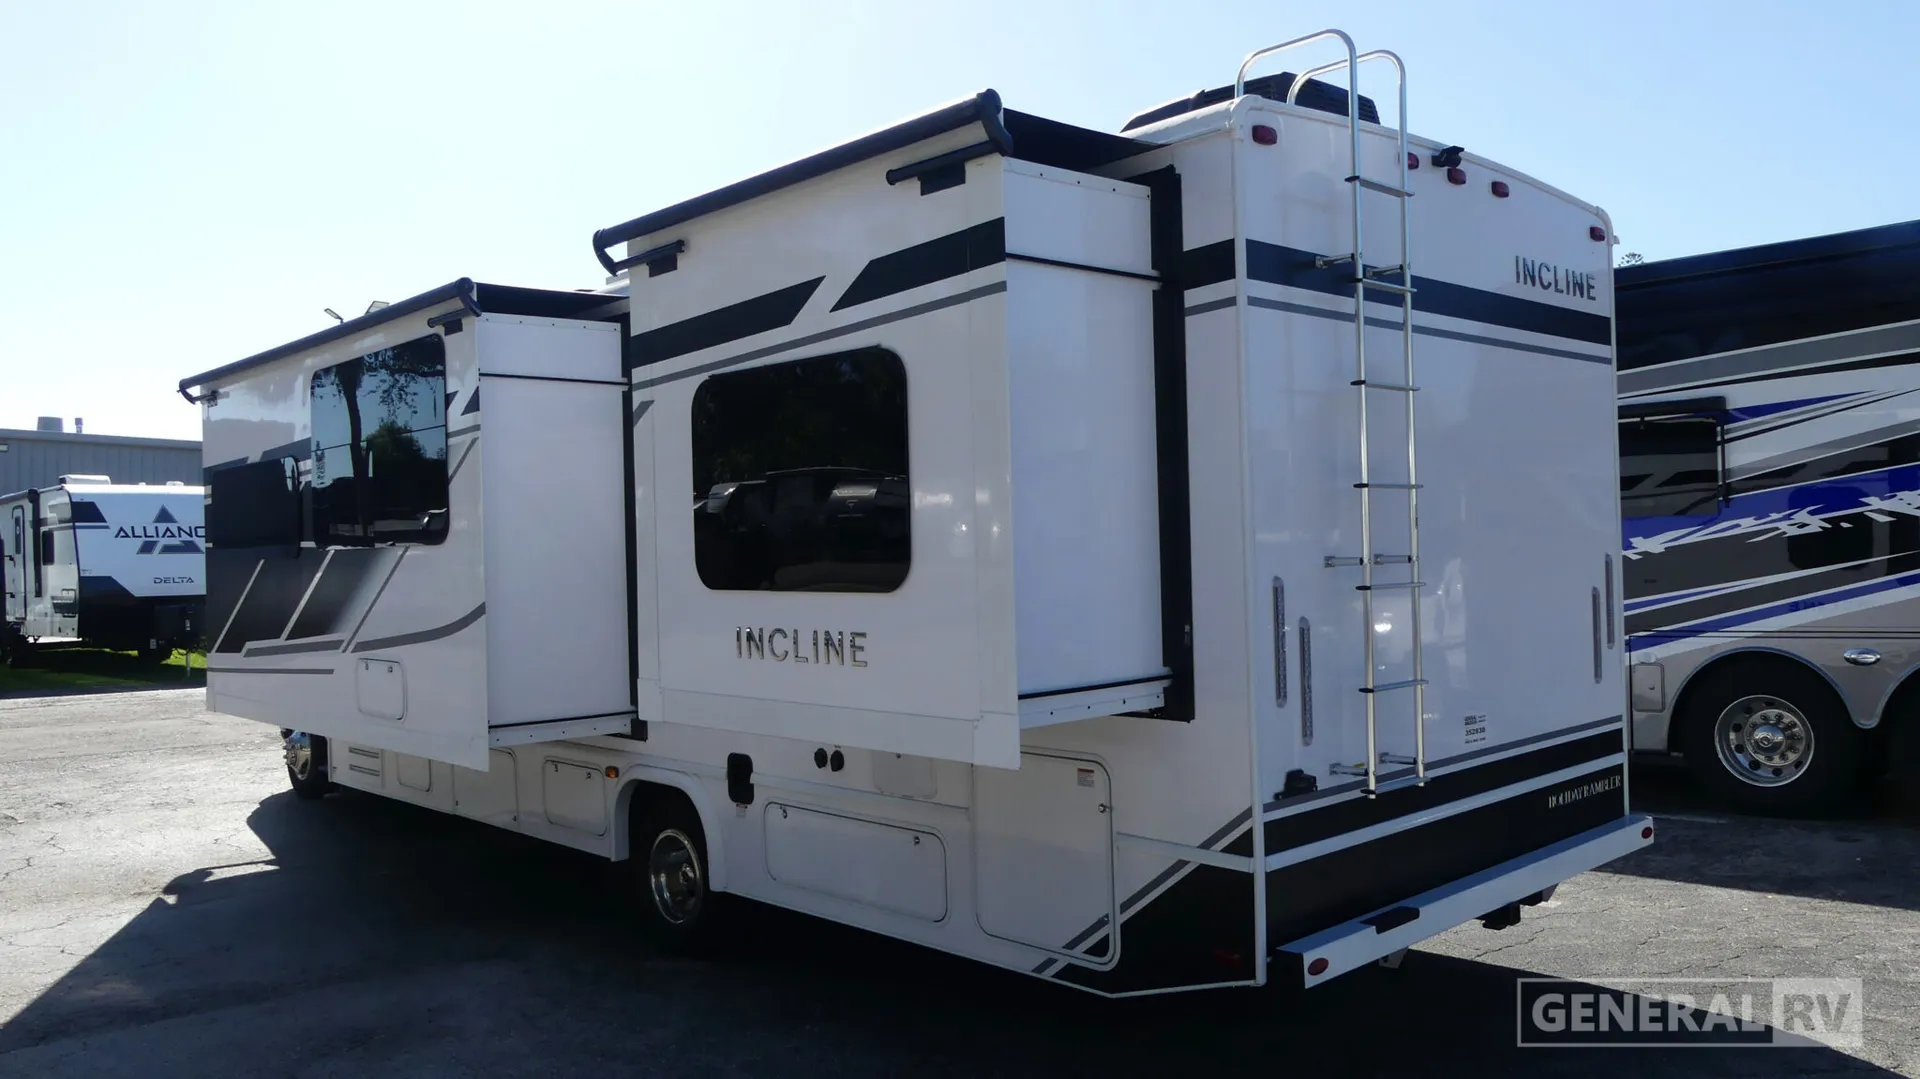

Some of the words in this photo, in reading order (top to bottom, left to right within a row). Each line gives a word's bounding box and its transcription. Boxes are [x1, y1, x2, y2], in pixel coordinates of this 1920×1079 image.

[1515, 255, 1596, 301] INCLINE
[114, 525, 206, 538] ALLIANC
[153, 576, 195, 584] DELTA
[736, 626, 868, 668] INCLINE
